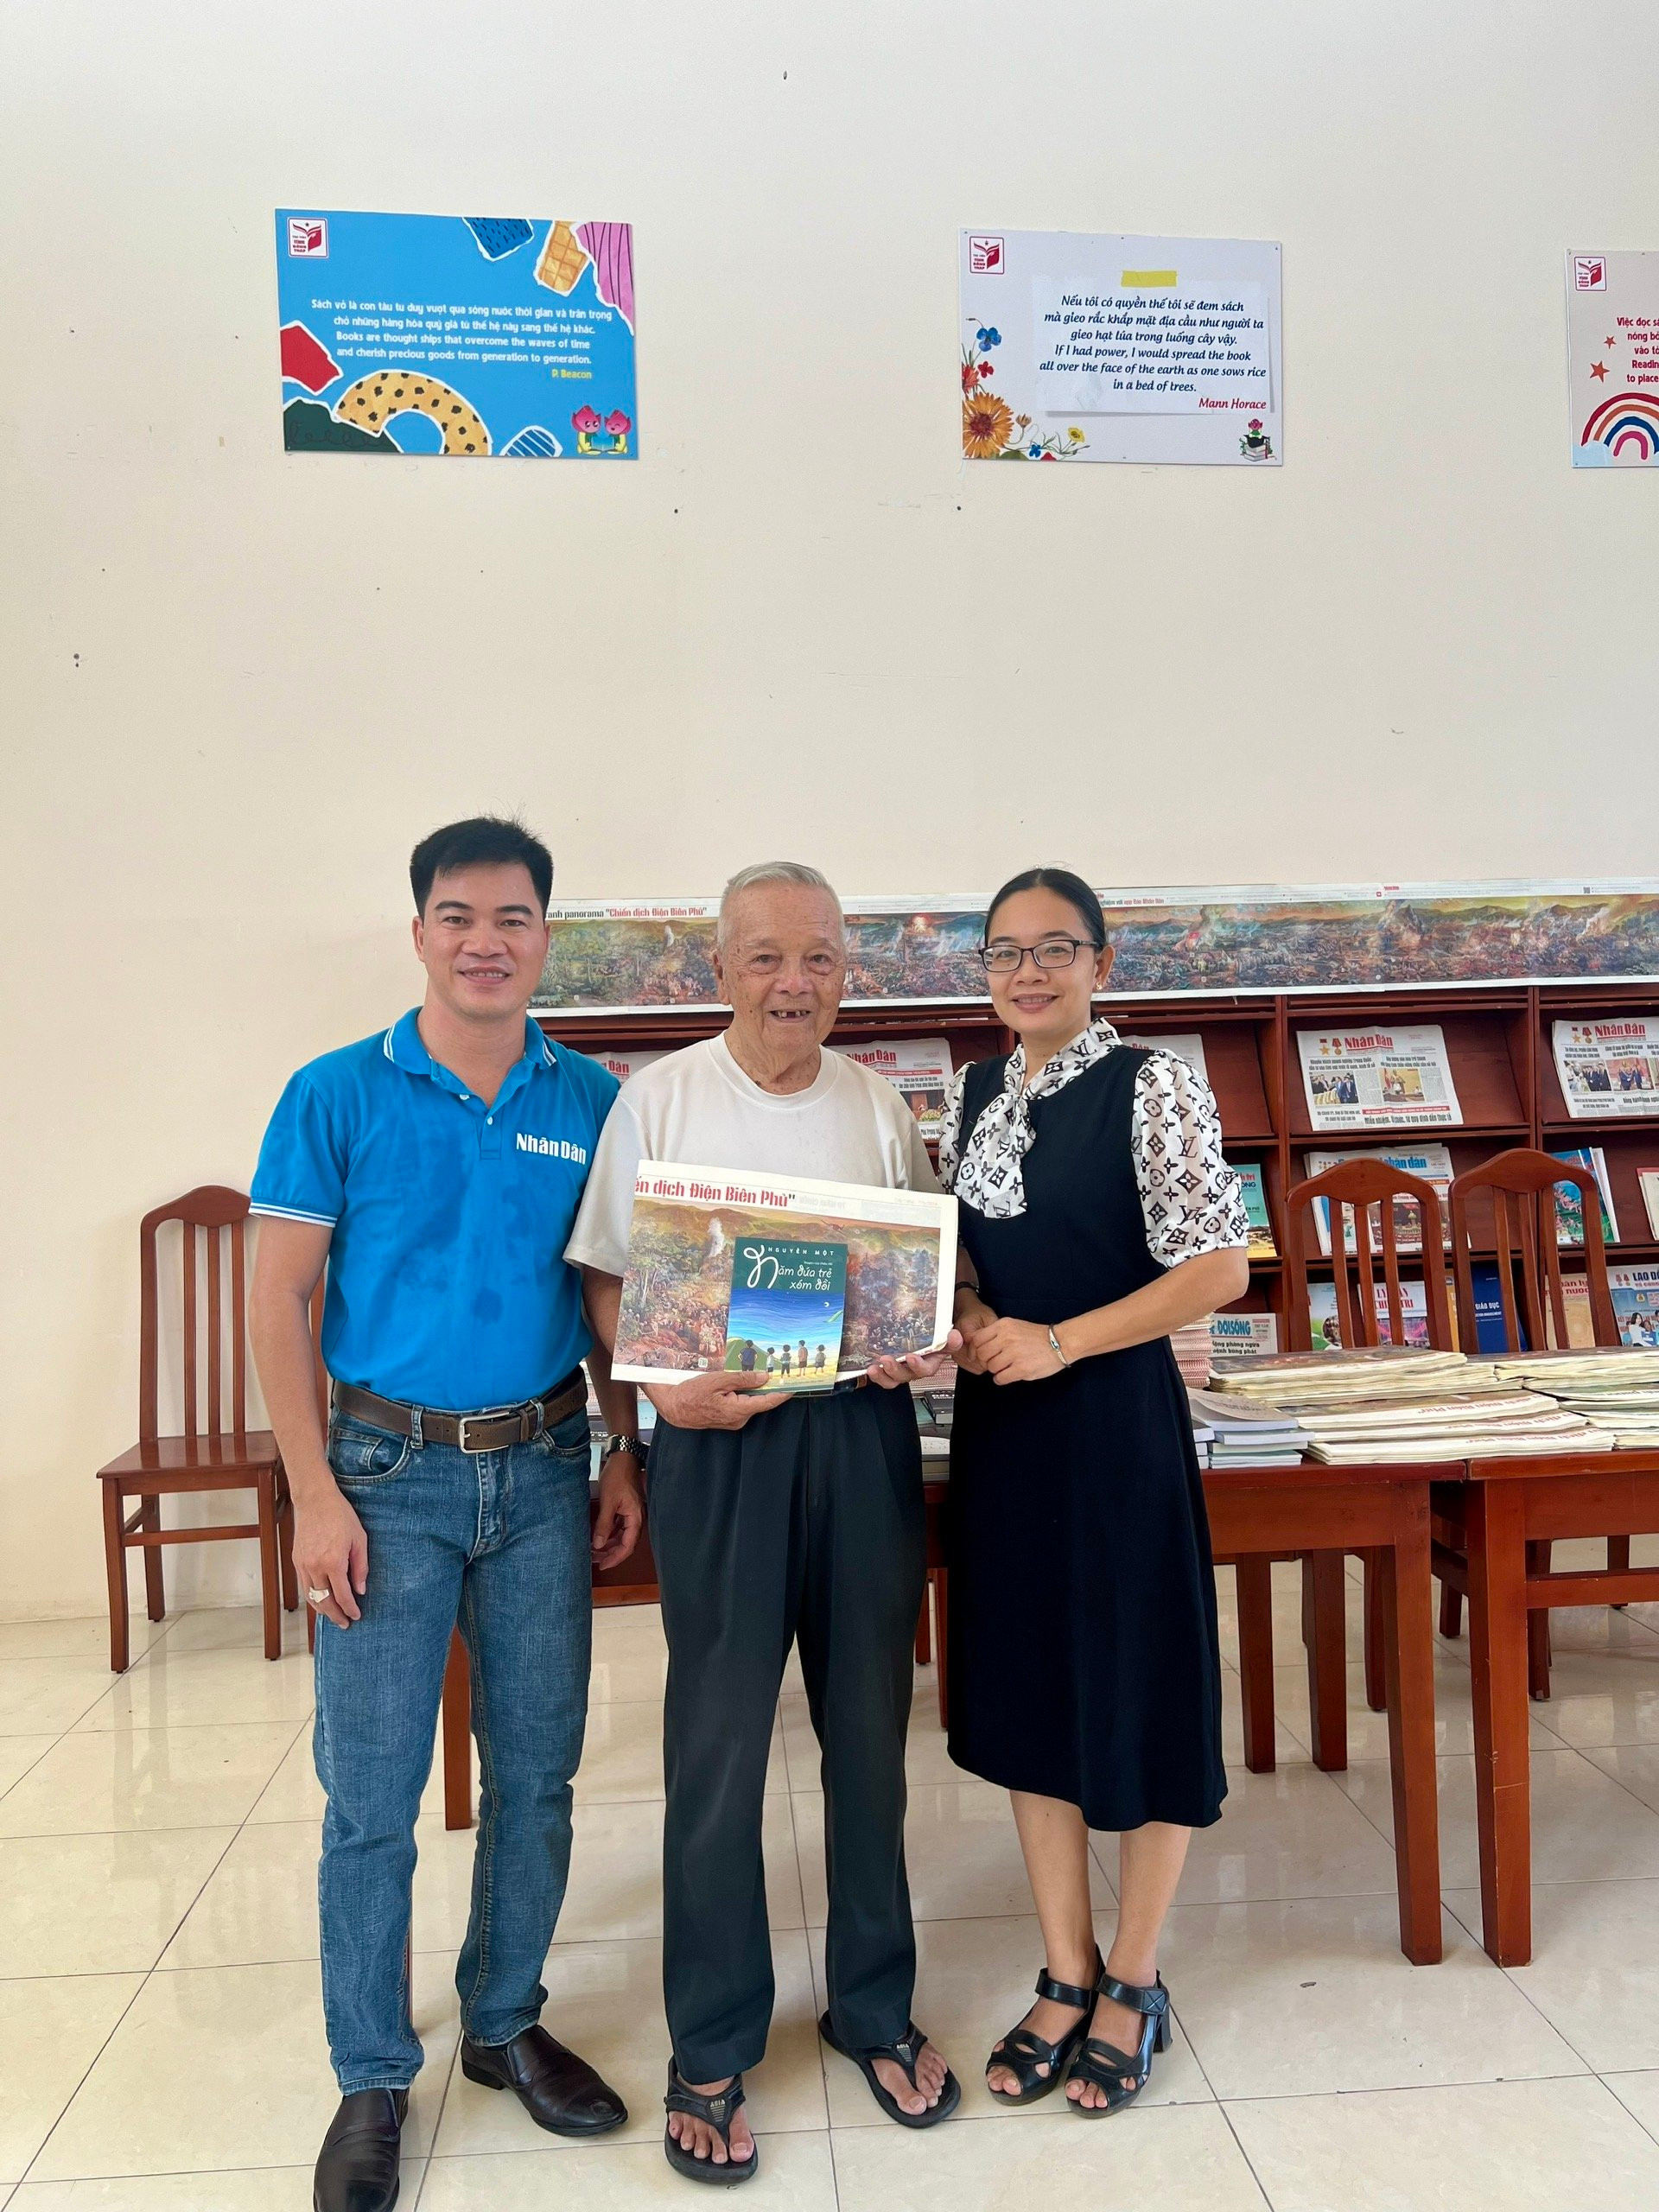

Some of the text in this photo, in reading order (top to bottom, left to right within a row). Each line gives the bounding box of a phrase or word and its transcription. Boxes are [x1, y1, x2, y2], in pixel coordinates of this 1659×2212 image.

[407, 303, 423, 315] duy
[449, 305, 466, 315] qua
[1061, 295, 1244, 311] Nếu tôi có quyền thế tôi sẽ đem sách
[1044, 311, 1263, 330] mà gieo rắc khắp mặt địa cầu như người ta
[521, 324, 541, 334] sang
[336, 331, 590, 348] Books are thought ships that overcome the waves of time
[1070, 329, 1237, 346] gieo hạt lúa trong luống cây vậy.
[337, 347, 592, 365] and cherish precious goods from generation to generation.
[1055, 345, 1065, 356] If
[1072, 346, 1092, 356] had
[1095, 349, 1128, 359] power,
[1138, 349, 1169, 359] would
[1171, 350, 1206, 360] spread
[1208, 351, 1224, 359] the
[1227, 351, 1251, 361] book
[561, 369, 592, 378] Beacon
[1039, 361, 1054, 371] all
[1057, 363, 1079, 372] over
[1082, 363, 1098, 372] the
[1100, 363, 1122, 373] face
[1125, 364, 1137, 374] of
[1139, 364, 1154, 373] the
[1157, 365, 1185, 374] earth
[1221, 368, 1244, 377] sows
[1247, 367, 1266, 377] rice
[1113, 379, 1123, 390] in
[1135, 380, 1154, 391] bed
[1156, 380, 1168, 392] of
[1170, 382, 1197, 391] trees.
[1198, 397, 1267, 409] Mann Horace
[564, 911, 604, 919] panorama
[1595, 1023, 1645, 1037] Nhân Dân
[1344, 1034, 1393, 1048] Nhân Dân
[876, 1049, 896, 1061] Dân
[608, 1059, 629, 1073] Dân
[517, 1132, 586, 1165] Nhân Dân
[1408, 1157, 1427, 1168] dân
[653, 1179, 684, 1197] dịch
[690, 1183, 721, 1202] Điện
[725, 1185, 756, 1204] Biên
[798, 1264, 815, 1277] đứa
[818, 1268, 831, 1278] trẻ
[1632, 1272, 1649, 1281] LAO
[789, 1279, 831, 1291] xóm đồi
